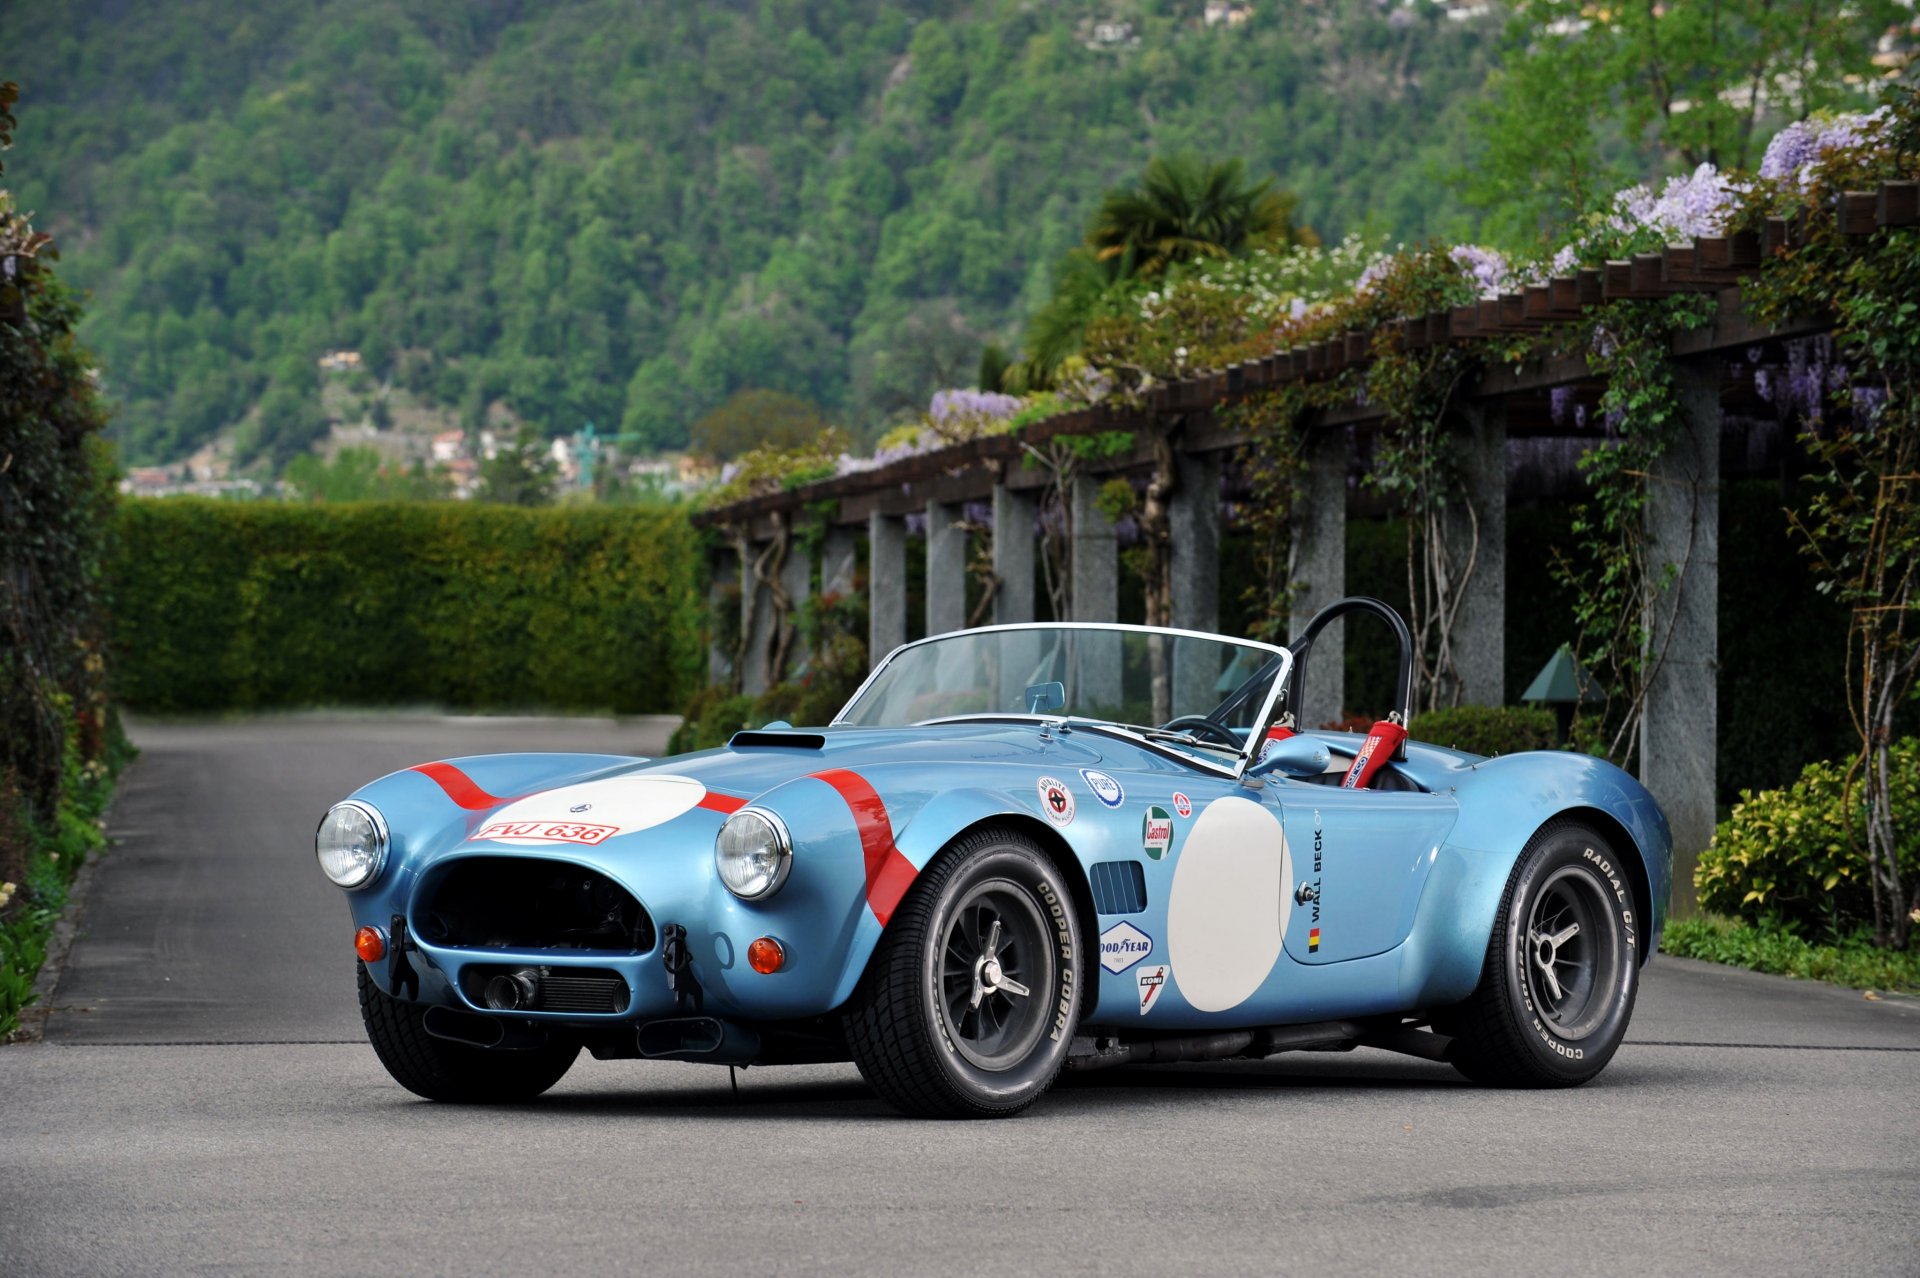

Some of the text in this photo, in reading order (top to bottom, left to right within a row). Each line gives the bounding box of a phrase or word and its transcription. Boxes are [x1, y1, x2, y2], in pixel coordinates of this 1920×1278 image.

[1147, 820, 1170, 840] Castrol
[1311, 829, 1322, 923] WALL BECK
[1583, 847, 1636, 949] RADIAL G/T
[1037, 882, 1073, 1043] COOPER COBRA
[1141, 977, 1162, 985] KONI
[1533, 1018, 1584, 1060] COOPER
